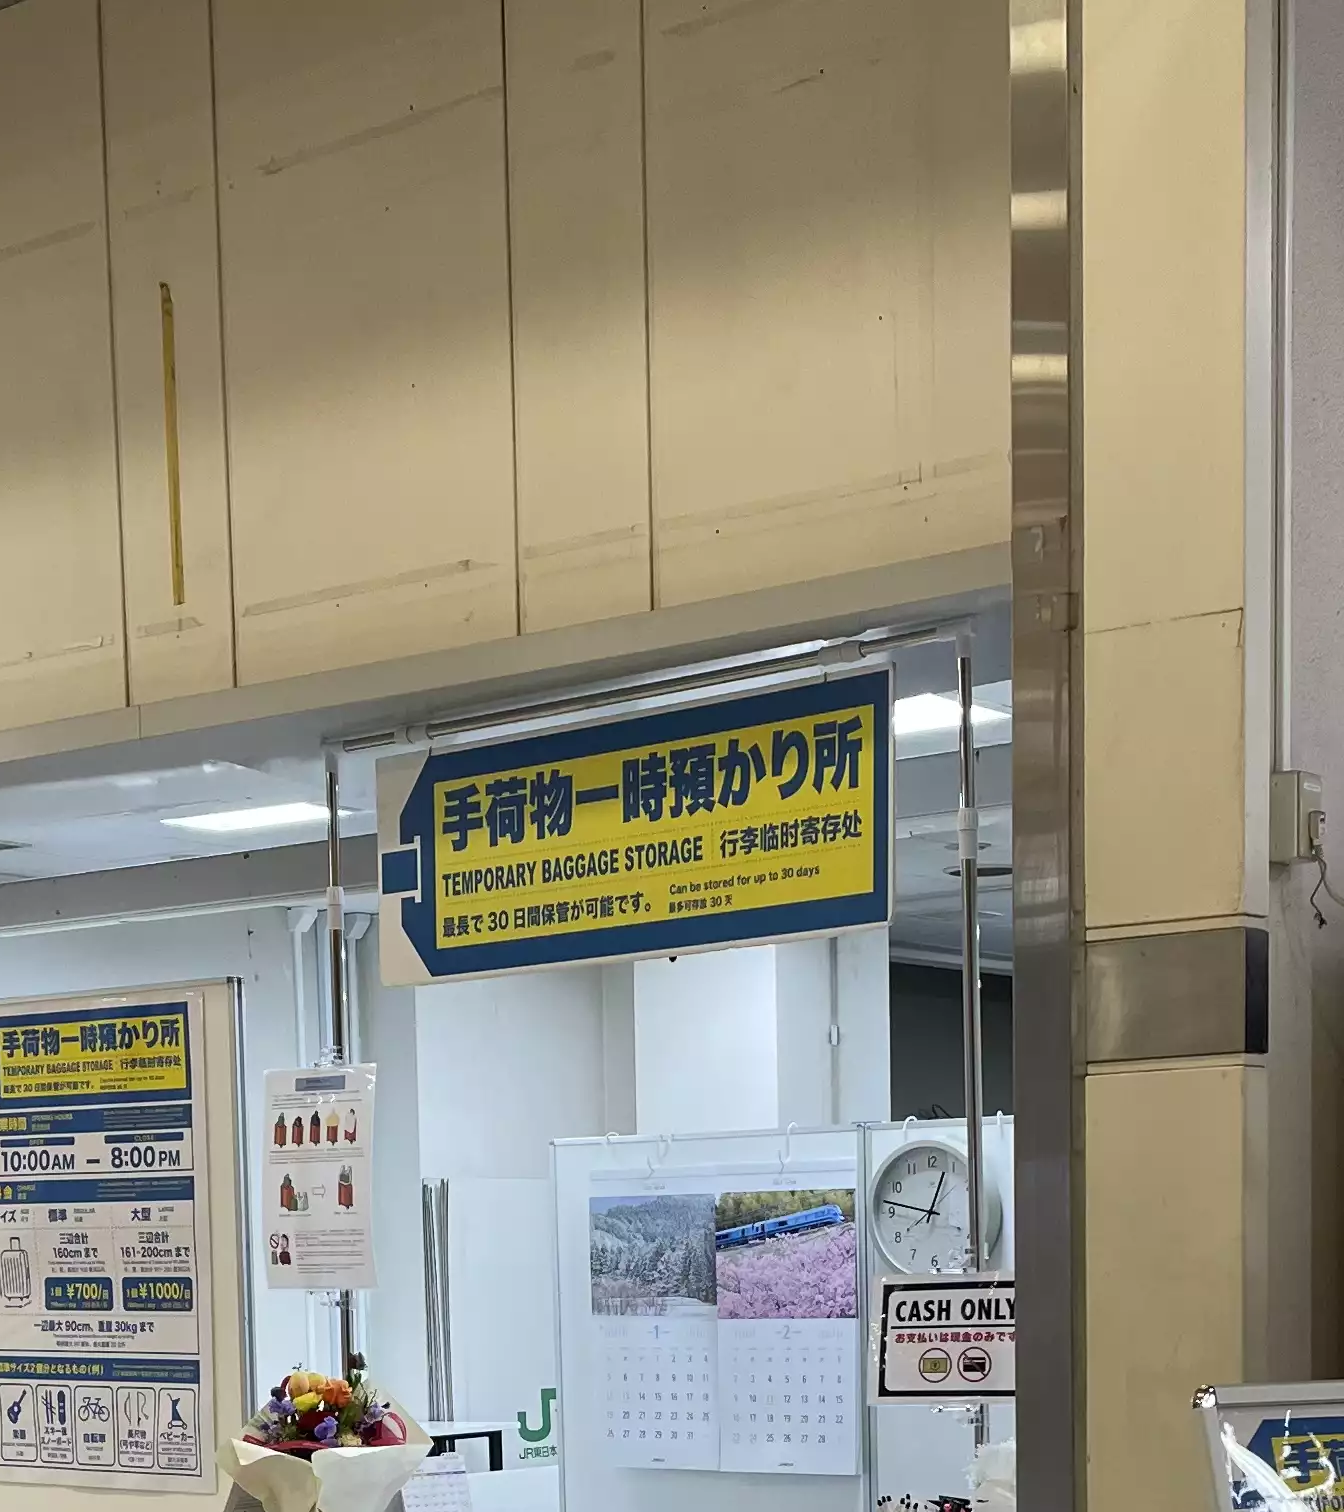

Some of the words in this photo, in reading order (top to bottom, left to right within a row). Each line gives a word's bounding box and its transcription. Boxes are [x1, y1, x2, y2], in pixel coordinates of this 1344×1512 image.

[442, 716, 863, 852] 手荷物一時預かり所
[719, 810, 862, 860] 行李临时寄存处
[442, 861, 537, 898] TEMPORARY
[542, 848, 619, 884] BAGGAGE
[624, 837, 703, 871] STORAGE
[669, 882, 687, 895] Can
[691, 879, 702, 892] be
[705, 875, 734, 892] stored
[737, 874, 752, 888] for
[754, 873, 766, 888] up
[769, 872, 779, 883] to
[782, 868, 794, 881] 30
[797, 864, 820, 880] days
[710, 897, 722, 908] 30
[442, 915, 484, 938] 最長で
[488, 911, 509, 932] 30
[514, 892, 651, 930] 日間保管が可能です。
[2, 1018, 180, 1058] 手荷物一時預かり所
[3, 1064, 44, 1077] TEMPORARY
[47, 1061, 80, 1074] BAGGAGE
[82, 1059, 113, 1072] STORAGE
[908, 1162, 916, 1174] 11
[927, 1156, 937, 1168] 12
[892, 1182, 902, 1194] 10
[131, 1208, 151, 1222] 大型
[888, 1207, 895, 1218] 9
[60, 1233, 88, 1245] 三辺合計
[138, 1232, 169, 1243] 三辺合計
[894, 1232, 902, 1243] 8
[53, 1247, 82, 1258] 160cm
[84, 1247, 98, 1258] まで
[120, 1247, 172, 1258] 161-200cm
[175, 1247, 190, 1257] まで
[910, 1248, 917, 1260] 7
[931, 1255, 938, 1267] 6
[896, 1300, 951, 1322] CASH
[961, 1299, 1015, 1320] ONLY
[115, 1322, 137, 1334] 30kg
[140, 1321, 154, 1332] まで
[83, 1434, 106, 1443] 自転車
[519, 1445, 557, 1459] JR東日本
